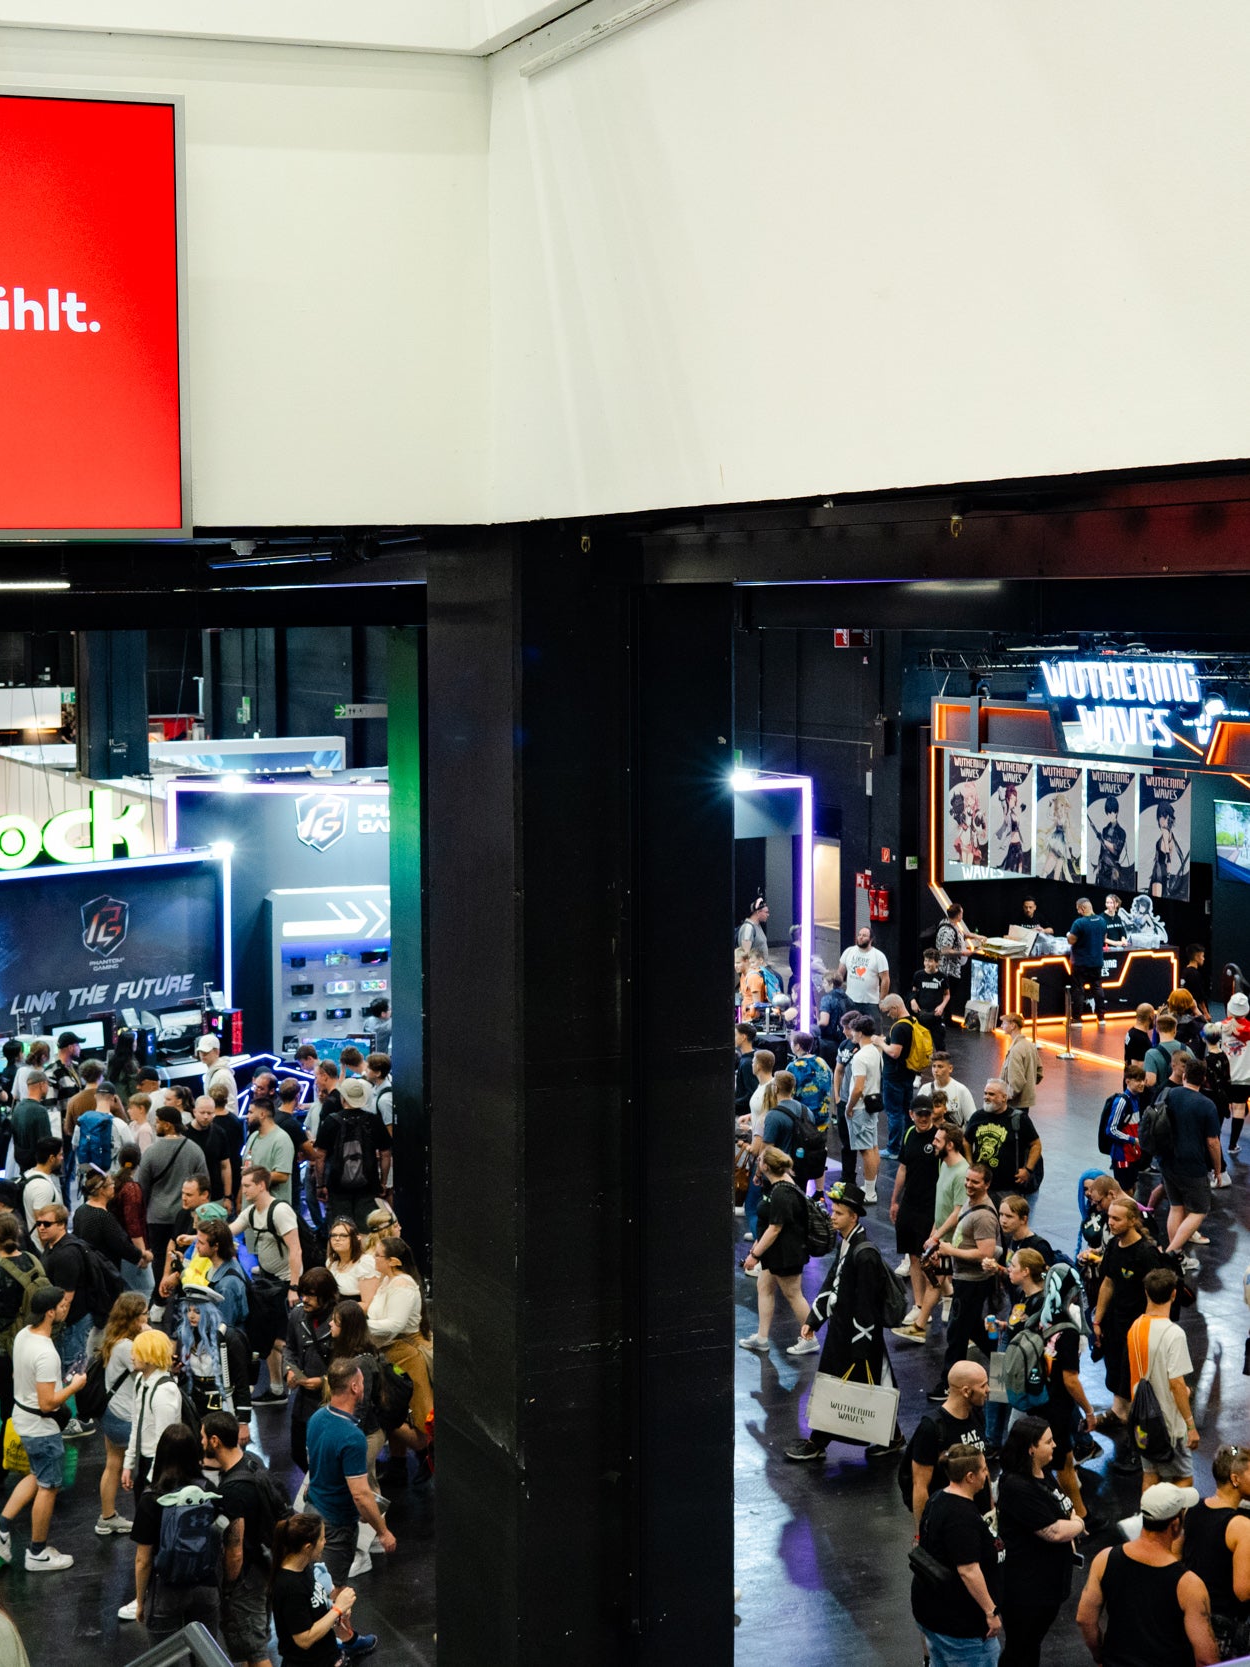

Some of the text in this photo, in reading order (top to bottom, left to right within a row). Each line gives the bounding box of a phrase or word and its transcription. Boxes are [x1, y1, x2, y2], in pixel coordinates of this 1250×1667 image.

[1040, 660, 1200, 704] WUTHERING
[1076, 704, 1175, 748] WAVES
[953, 756, 986, 769] WUTHERING
[995, 761, 1028, 774] WUTHERING
[960, 767, 979, 779] WAVES
[1002, 772, 1023, 784] WAVES
[1042, 766, 1078, 779] WUTHERING
[1091, 771, 1130, 784] WUTHERING
[1049, 777, 1071, 790] WAVES
[1098, 783, 1122, 795] WAVES
[1145, 775, 1186, 790] WUTHERING
[1153, 789, 1178, 801] WAVES
[10, 973, 195, 1015] LINK THE FUTURE
[830, 1401, 876, 1418] WUTHERING
[838, 1411, 865, 1425] WAVES
[960, 1429, 980, 1445] EAT.
